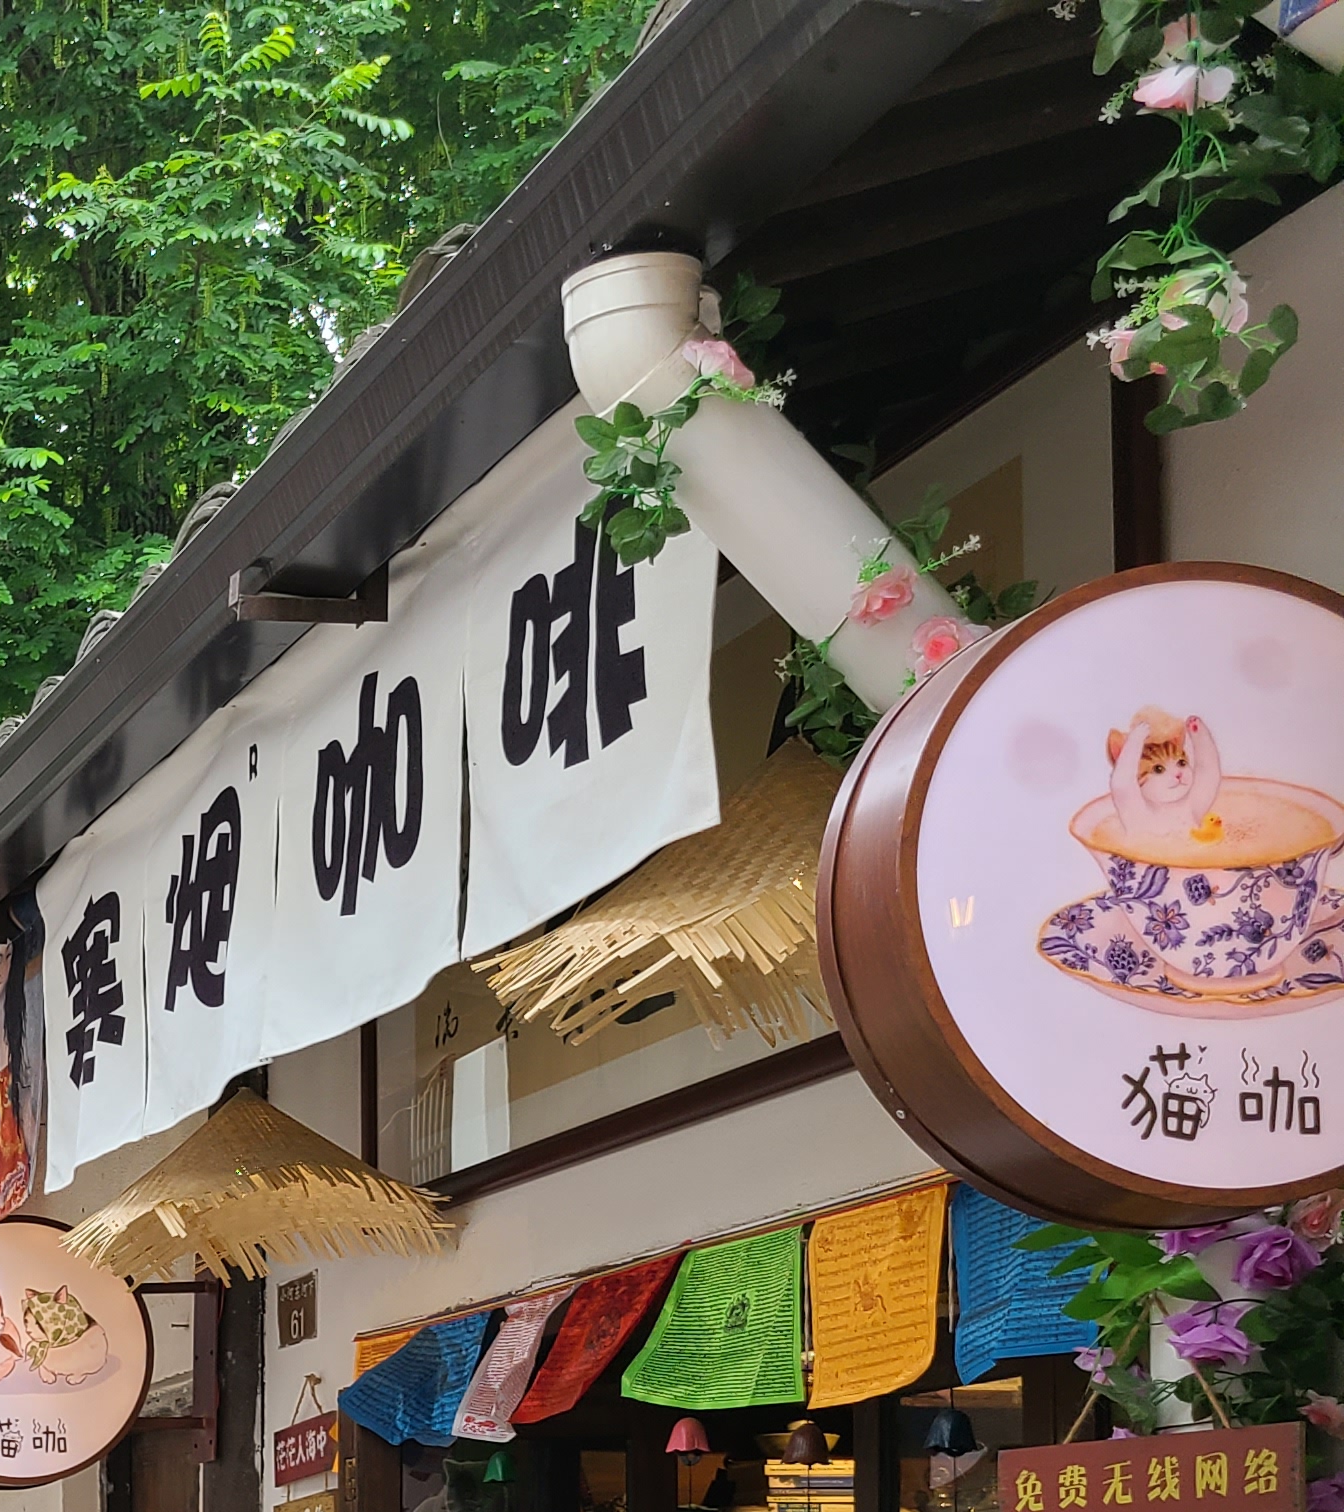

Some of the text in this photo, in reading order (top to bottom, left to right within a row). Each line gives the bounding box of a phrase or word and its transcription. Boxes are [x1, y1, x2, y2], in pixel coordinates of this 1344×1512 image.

[1120, 1042, 1322, 1142] 猫咖
[291, 1307, 305, 1339] 61
[275, 1425, 328, 1472] 茫茫人海中
[1014, 1448, 1280, 1512] 免费无线网络
